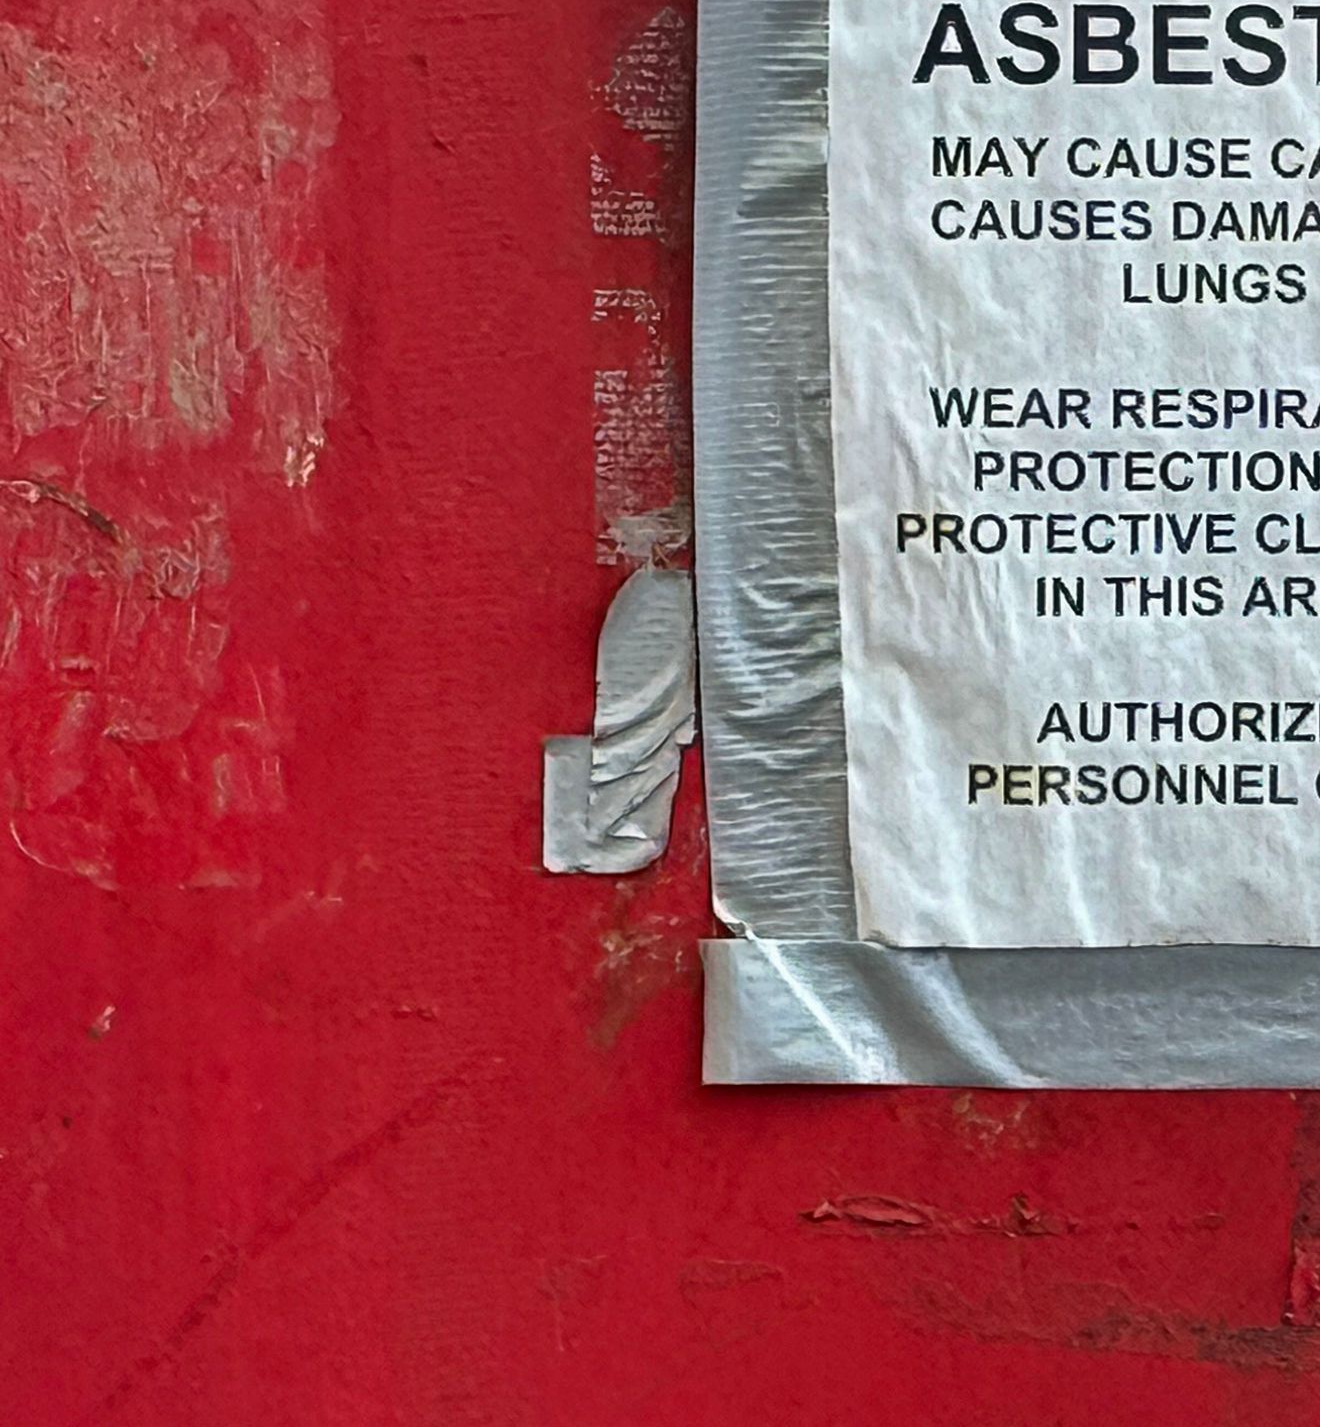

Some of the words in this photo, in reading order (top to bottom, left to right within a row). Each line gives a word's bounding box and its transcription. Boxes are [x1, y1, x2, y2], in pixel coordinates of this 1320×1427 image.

[933, 137, 1049, 177] MAY
[1067, 137, 1251, 178] CAUSE
[932, 200, 1152, 240] CAUSES
[1124, 263, 1306, 304] LUNGS
[929, 387, 1091, 429] WEAR
[975, 451, 1320, 492] PROTECTION
[897, 513, 1236, 555] PROTECTIVE
[1037, 577, 1084, 616] IN
[1104, 576, 1223, 616] THIS
[969, 764, 1298, 806] PERSONNEL
